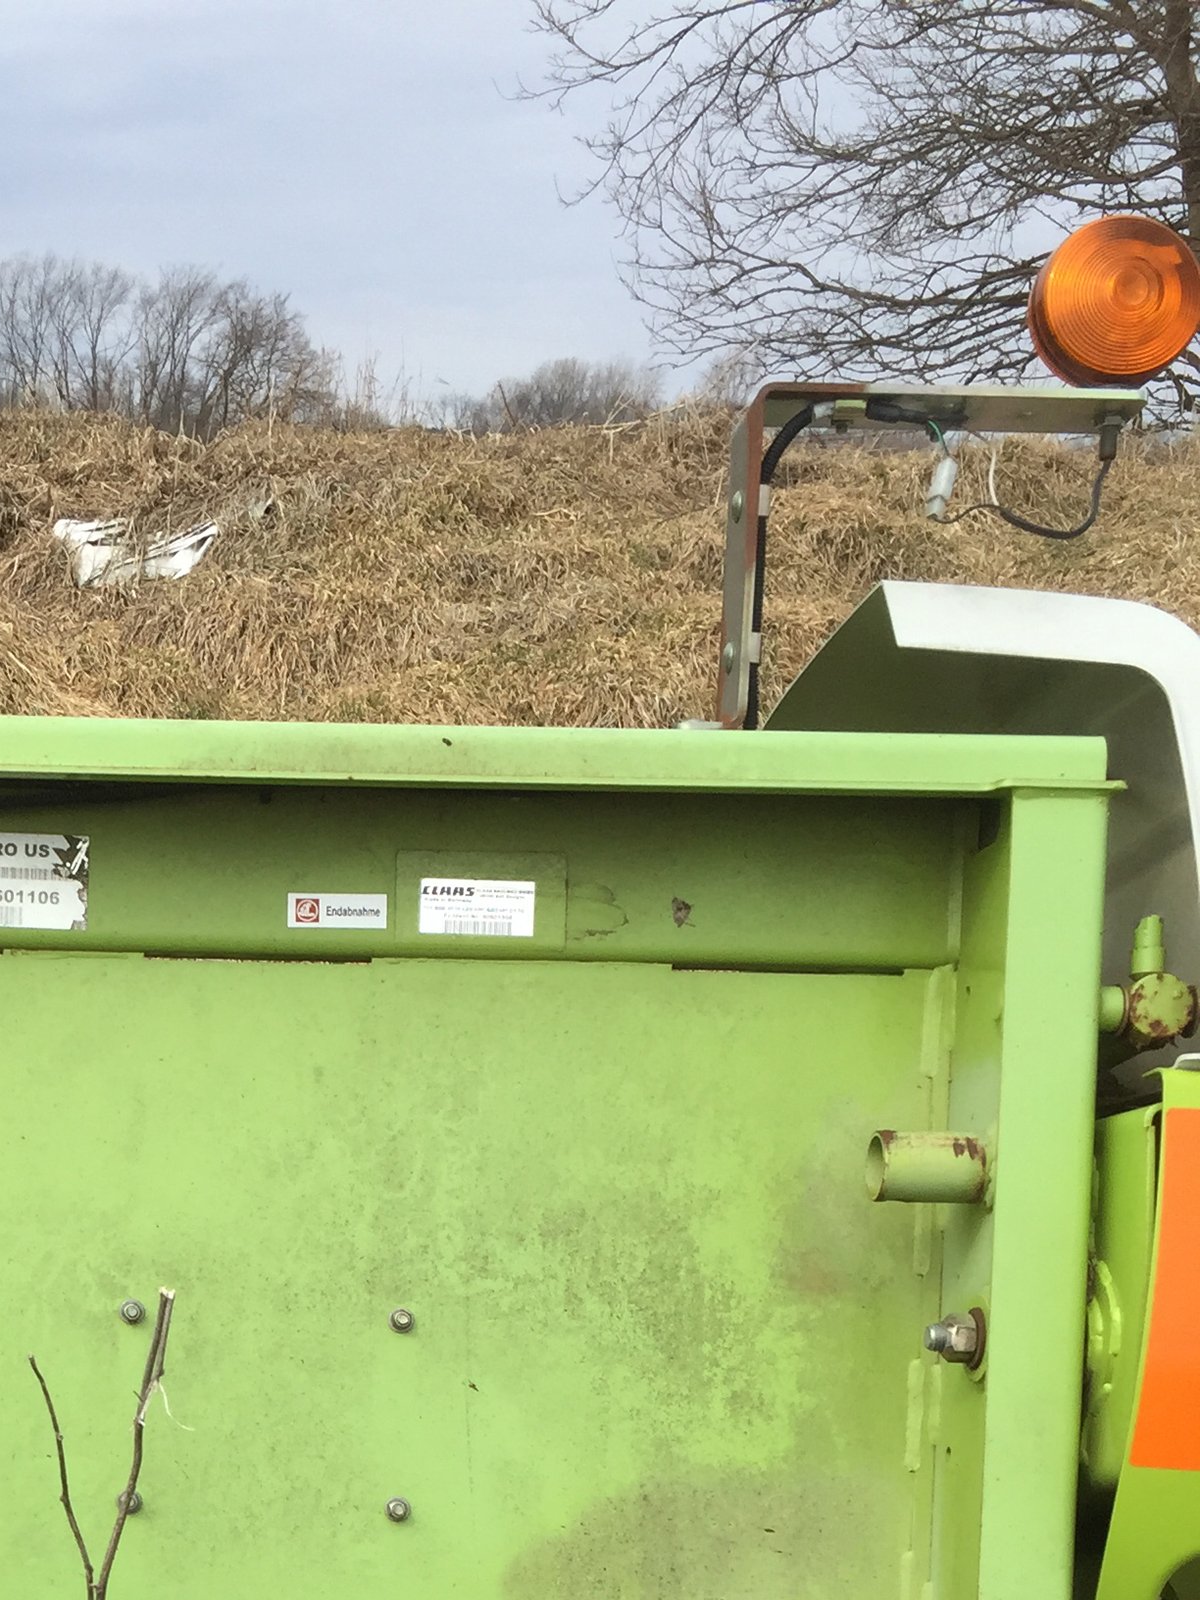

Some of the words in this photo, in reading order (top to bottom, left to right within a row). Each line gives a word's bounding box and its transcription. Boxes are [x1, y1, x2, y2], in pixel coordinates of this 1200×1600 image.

[24, 843, 50, 858] US
[422, 885, 476, 897] CLAAS
[326, 905, 381, 917] Endabnahme
